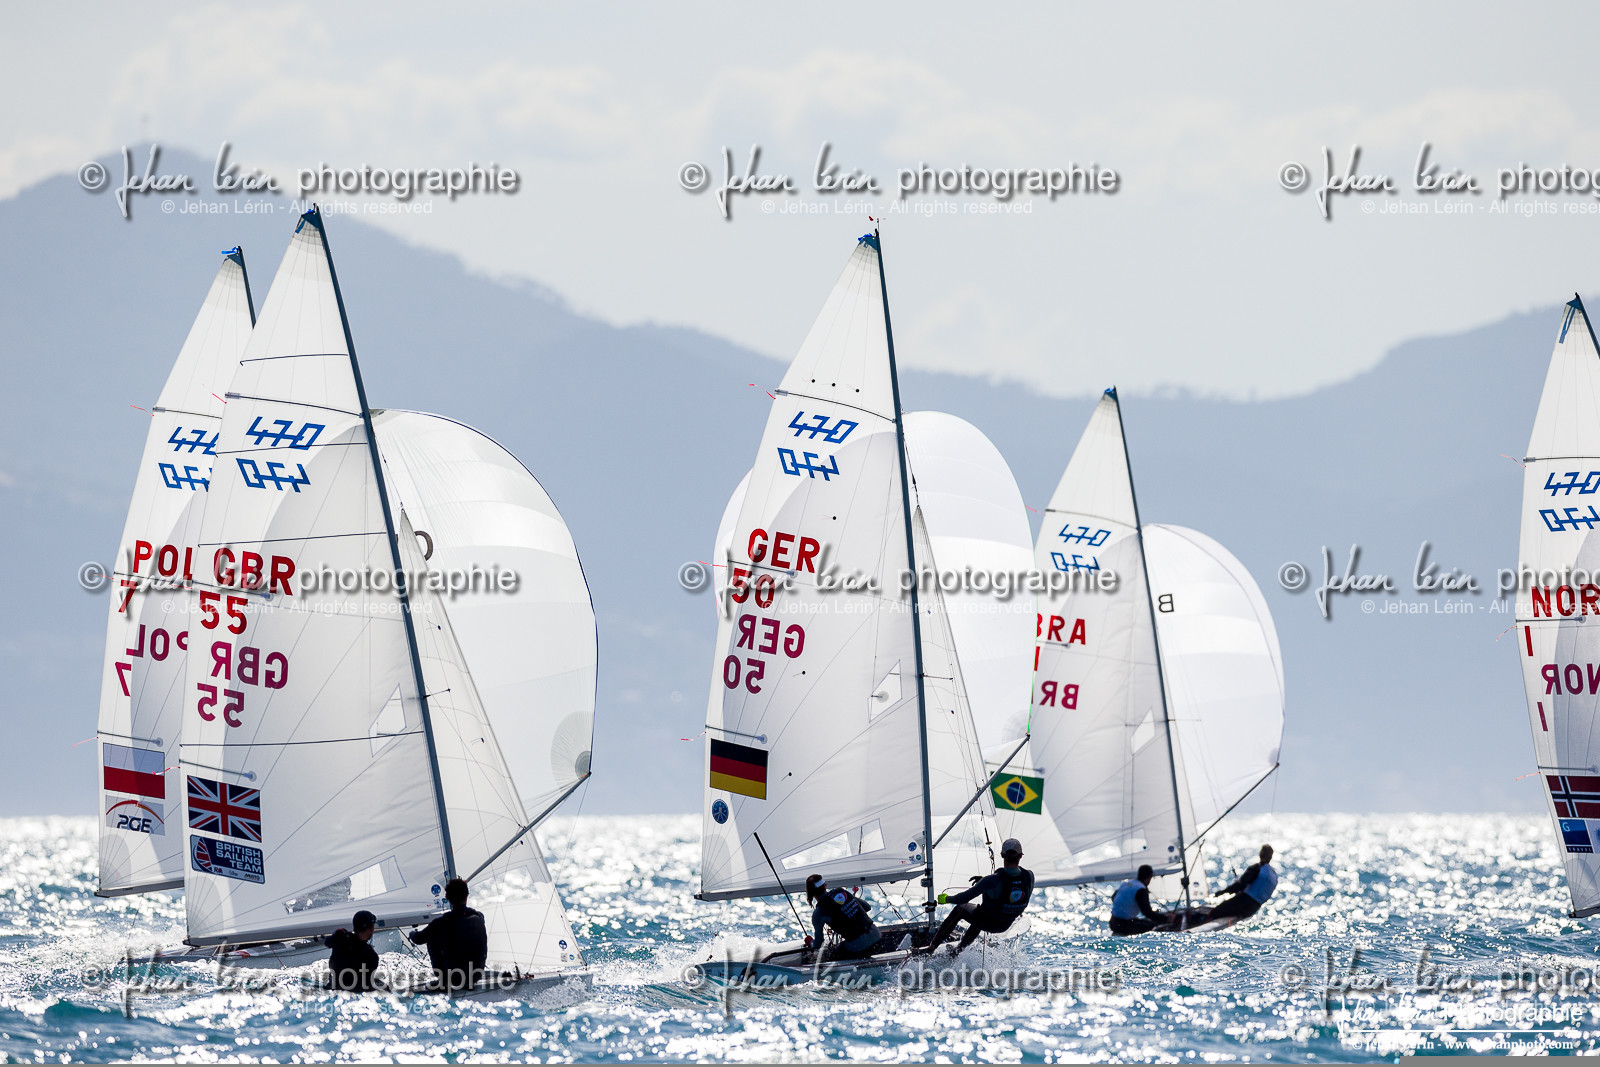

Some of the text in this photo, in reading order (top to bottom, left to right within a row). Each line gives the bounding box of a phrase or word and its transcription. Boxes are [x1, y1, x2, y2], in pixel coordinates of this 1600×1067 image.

[246, 416, 326, 450] 470
[789, 411, 858, 445] 470
[1544, 471, 1600, 496] 470
[747, 528, 821, 574] GER
[1058, 524, 1111, 547] 470
[213, 548, 296, 595] GBR
[731, 567, 775, 609] 50
[118, 579, 138, 613] 7
[199, 589, 249, 635] 55
[1531, 584, 1600, 617] NOR
[117, 814, 153, 834] PGE
[215, 841, 261, 859] BRITISH
[216, 849, 262, 866] SAILING
[229, 859, 262, 874] TEAM
